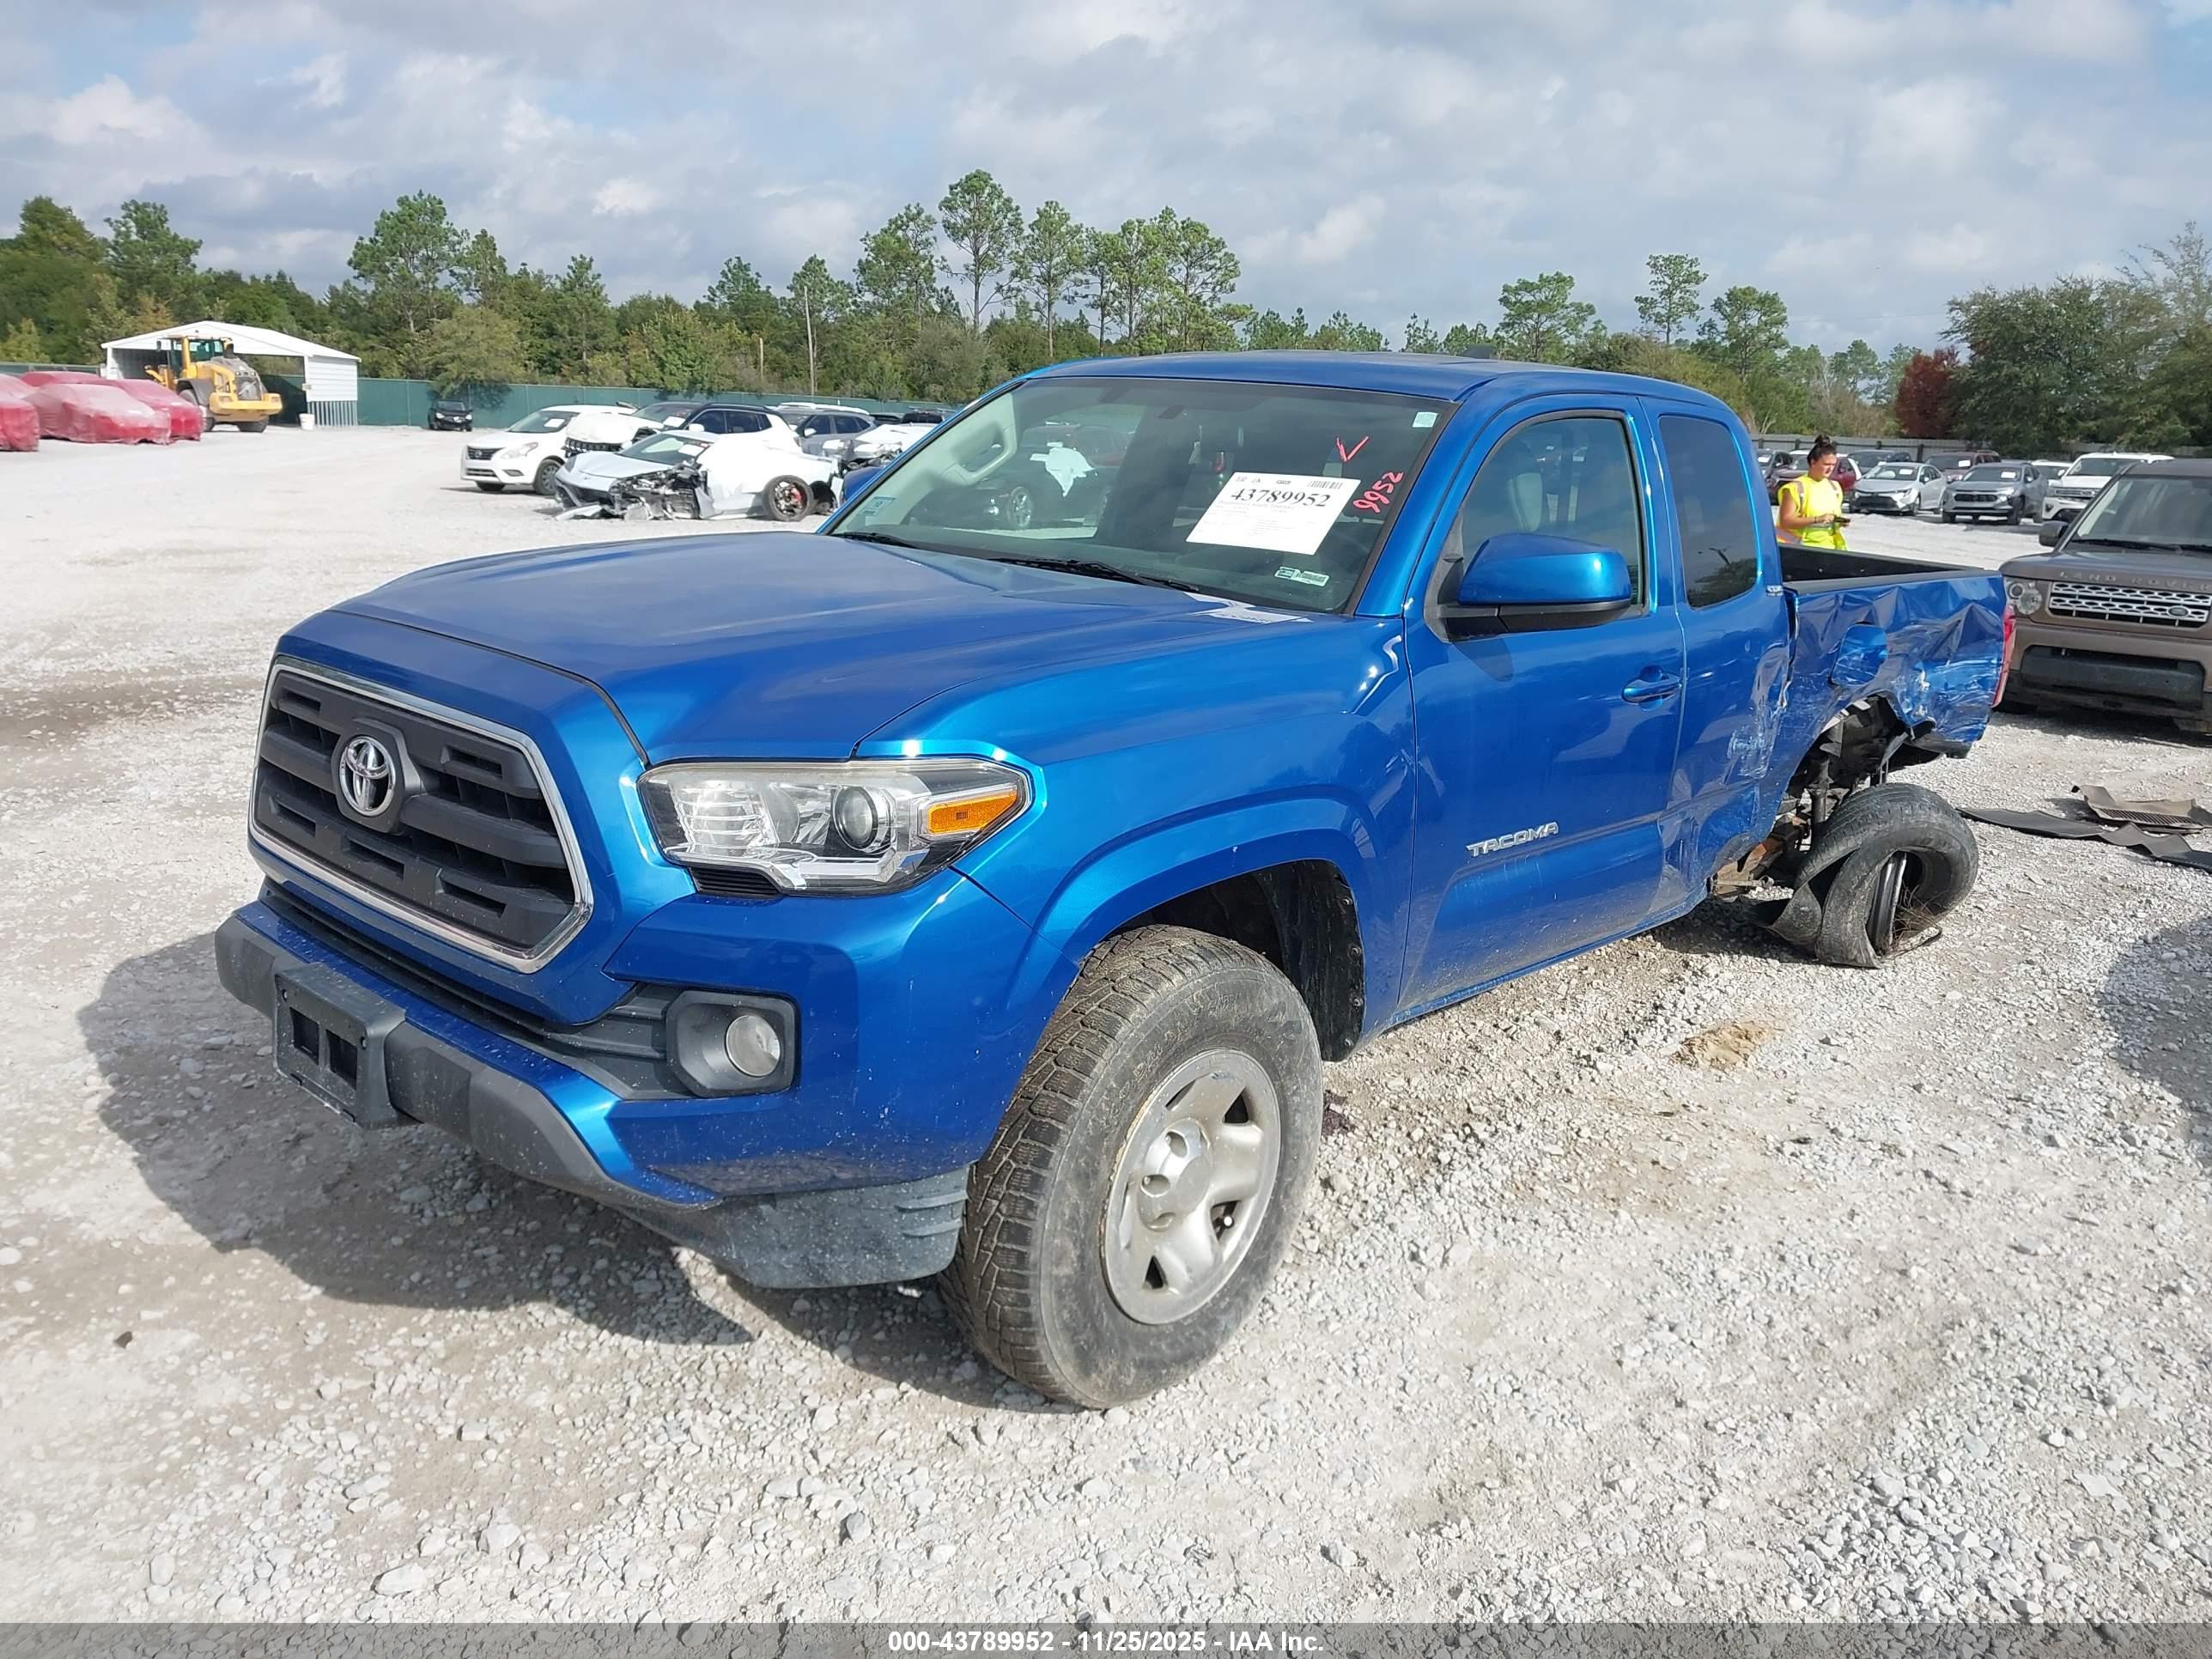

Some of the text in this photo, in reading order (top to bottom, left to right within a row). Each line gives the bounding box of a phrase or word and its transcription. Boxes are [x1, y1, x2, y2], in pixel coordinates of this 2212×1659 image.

[1231, 488, 1331, 507] 43789952
[1352, 471, 1404, 513] 9952
[2060, 571, 2212, 591] LAND ROVER
[1466, 821, 1559, 857] TACOMA
